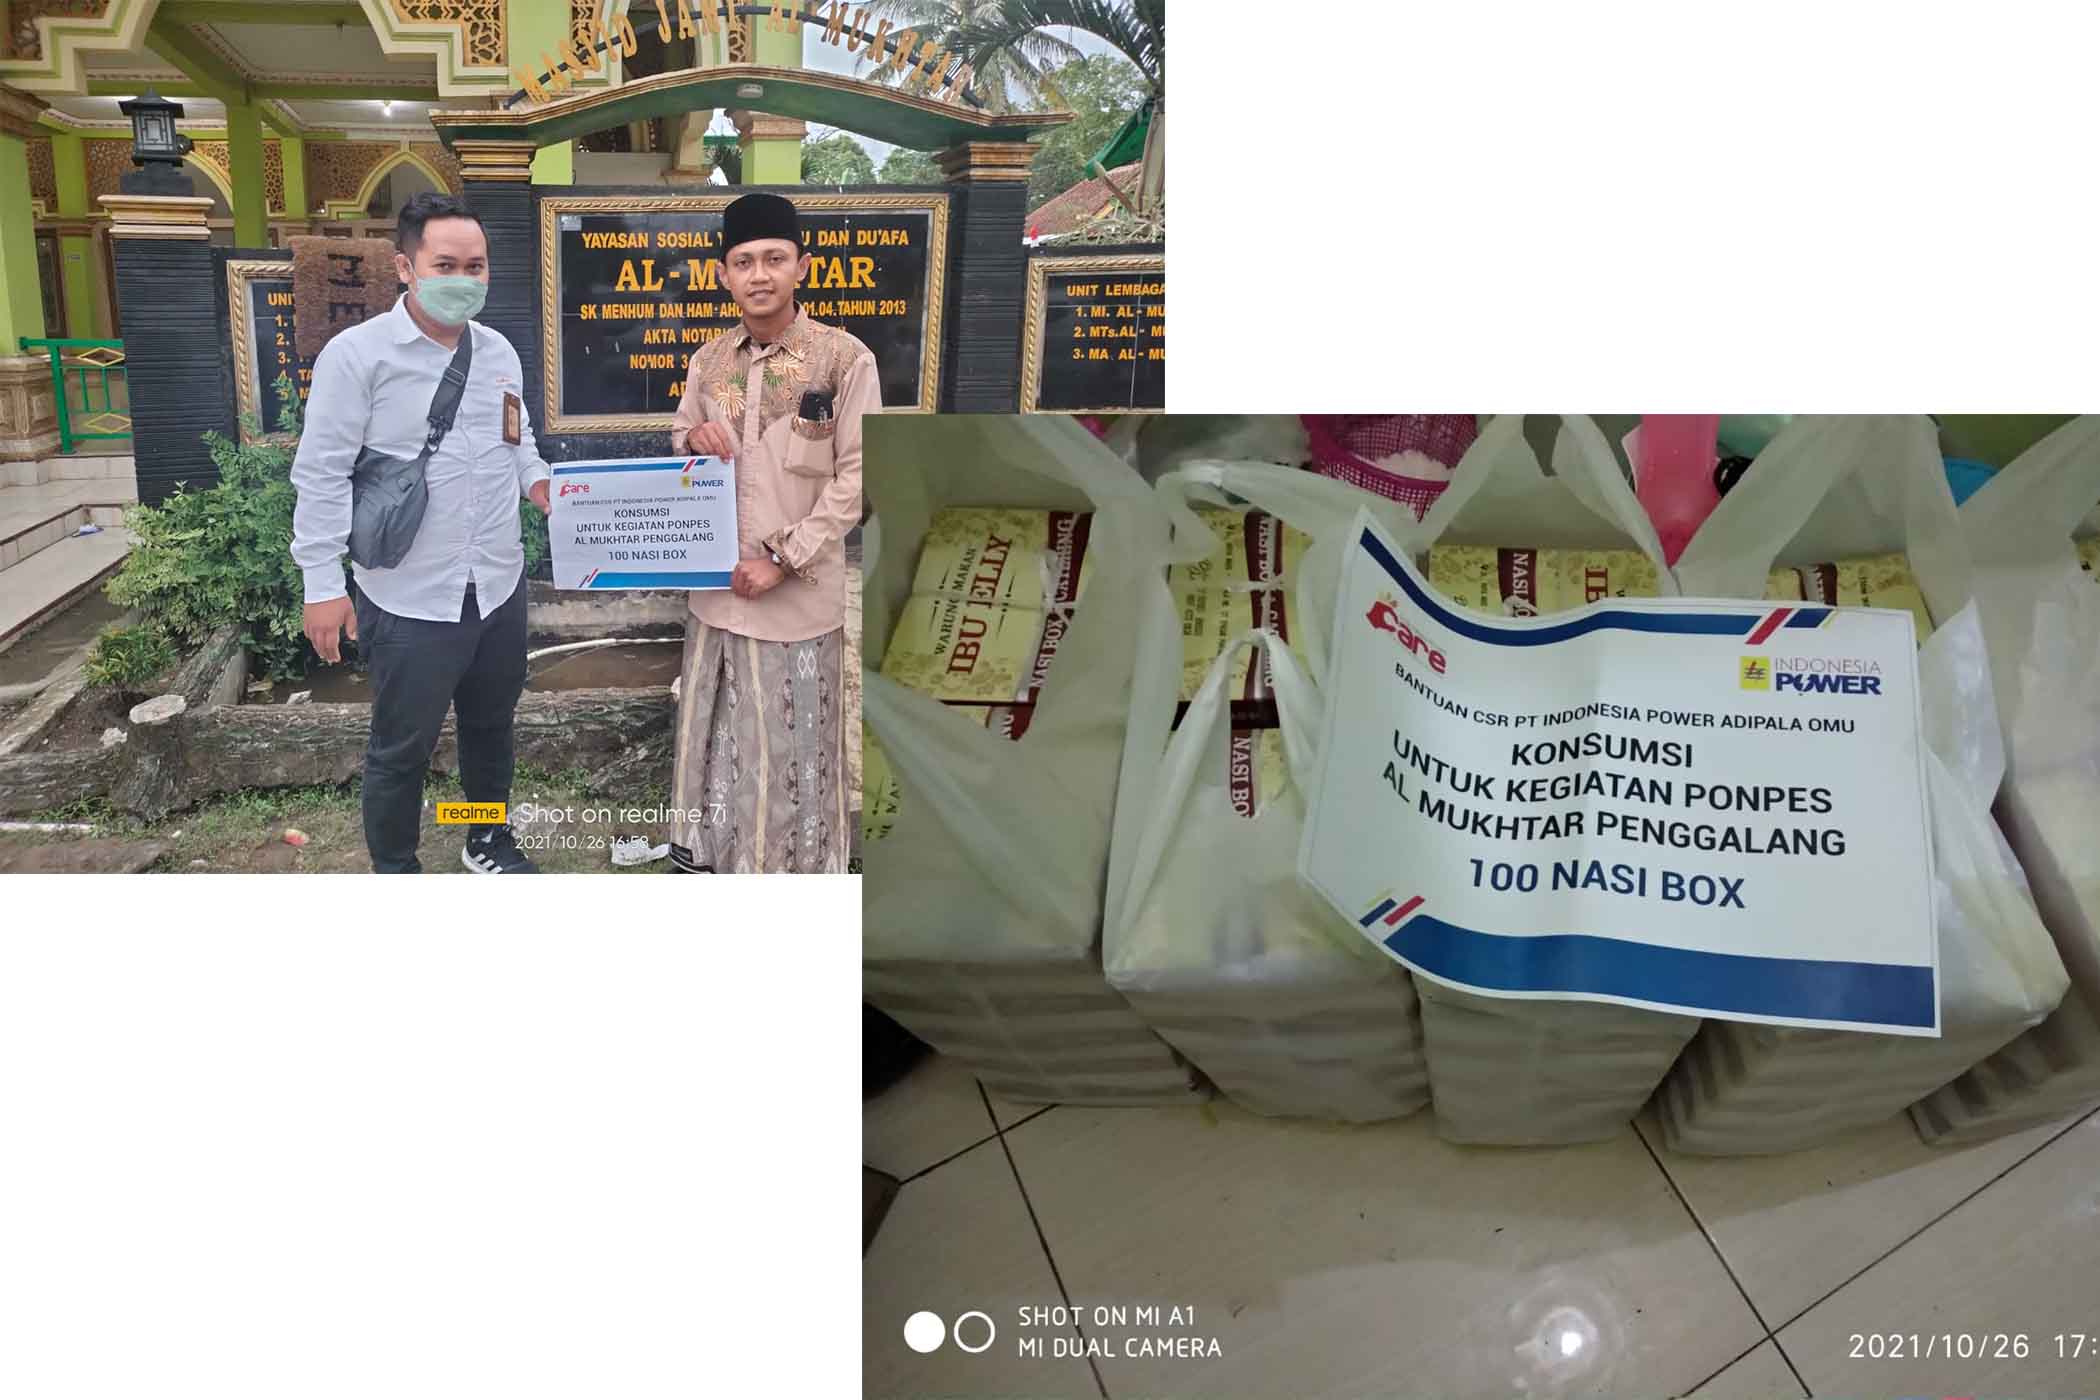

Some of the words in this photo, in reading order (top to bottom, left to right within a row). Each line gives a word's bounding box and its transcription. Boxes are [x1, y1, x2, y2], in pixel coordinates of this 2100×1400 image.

[582, 232, 649, 248] YAYASAN
[657, 232, 713, 248] SOSIAL
[817, 230, 849, 246] DAN
[857, 229, 909, 245] DU'AFA
[1066, 285, 1099, 297] UNIT
[580, 304, 597, 319] SK
[602, 303, 655, 319] MENHUM
[659, 303, 684, 318] DAN
[879, 300, 906, 315] 2013
[1075, 305, 1087, 317] 1.
[1091, 305, 1110, 317] MI.
[275, 315, 288, 327] 1.
[276, 333, 290, 346] 2.
[643, 329, 676, 345] AKTA
[1073, 326, 1085, 338] 2.
[278, 351, 291, 364] 3.
[630, 354, 674, 369] NOMOR
[1072, 348, 1085, 360] 3.
[1088, 348, 1109, 360] MA
[614, 508, 670, 518] KONSUMSI
[576, 522, 612, 533] UNTUK
[614, 520, 665, 531] KEGIATAN
[668, 519, 710, 530] PONPES
[574, 536, 587, 545] AL
[590, 534, 640, 545] MUKHTAR
[643, 532, 714, 544] PENGGALANG
[608, 551, 628, 561] 100
[632, 550, 660, 560] NASI
[663, 549, 687, 560] BOX
[952, 546, 977, 591] MAKAN
[1512, 552, 1529, 598] NASI
[947, 615, 988, 675] IBU
[969, 533, 1012, 609] ELLY
[1042, 617, 1065, 650] BOX
[1030, 650, 1055, 688] NASI
[1775, 657, 1881, 674] INDONESIA
[1775, 673, 1881, 695] POWER
[1395, 662, 1468, 719] BANTUAN
[1473, 710, 1509, 727] CSR
[1515, 714, 1538, 728] PT
[1543, 702, 1641, 726] INDONESIA
[1647, 709, 1715, 728] POWER
[1720, 714, 1803, 731] ADIPALA
[1808, 718, 1855, 733] OMU
[1232, 736, 1250, 778] NASI
[1512, 732, 1692, 768] KONSUMSI
[1393, 729, 1496, 800] UNTUK
[1505, 770, 1672, 806] KEGIATAN
[1685, 782, 1832, 813] PONPES
[1383, 761, 1410, 803] AL
[1419, 790, 1584, 841] MUKHTAR
[1597, 810, 1846, 857] PENGGALANG
[1470, 858, 1539, 893] 100
[1552, 859, 1647, 897] NASI
[1661, 871, 1745, 909] BOX
